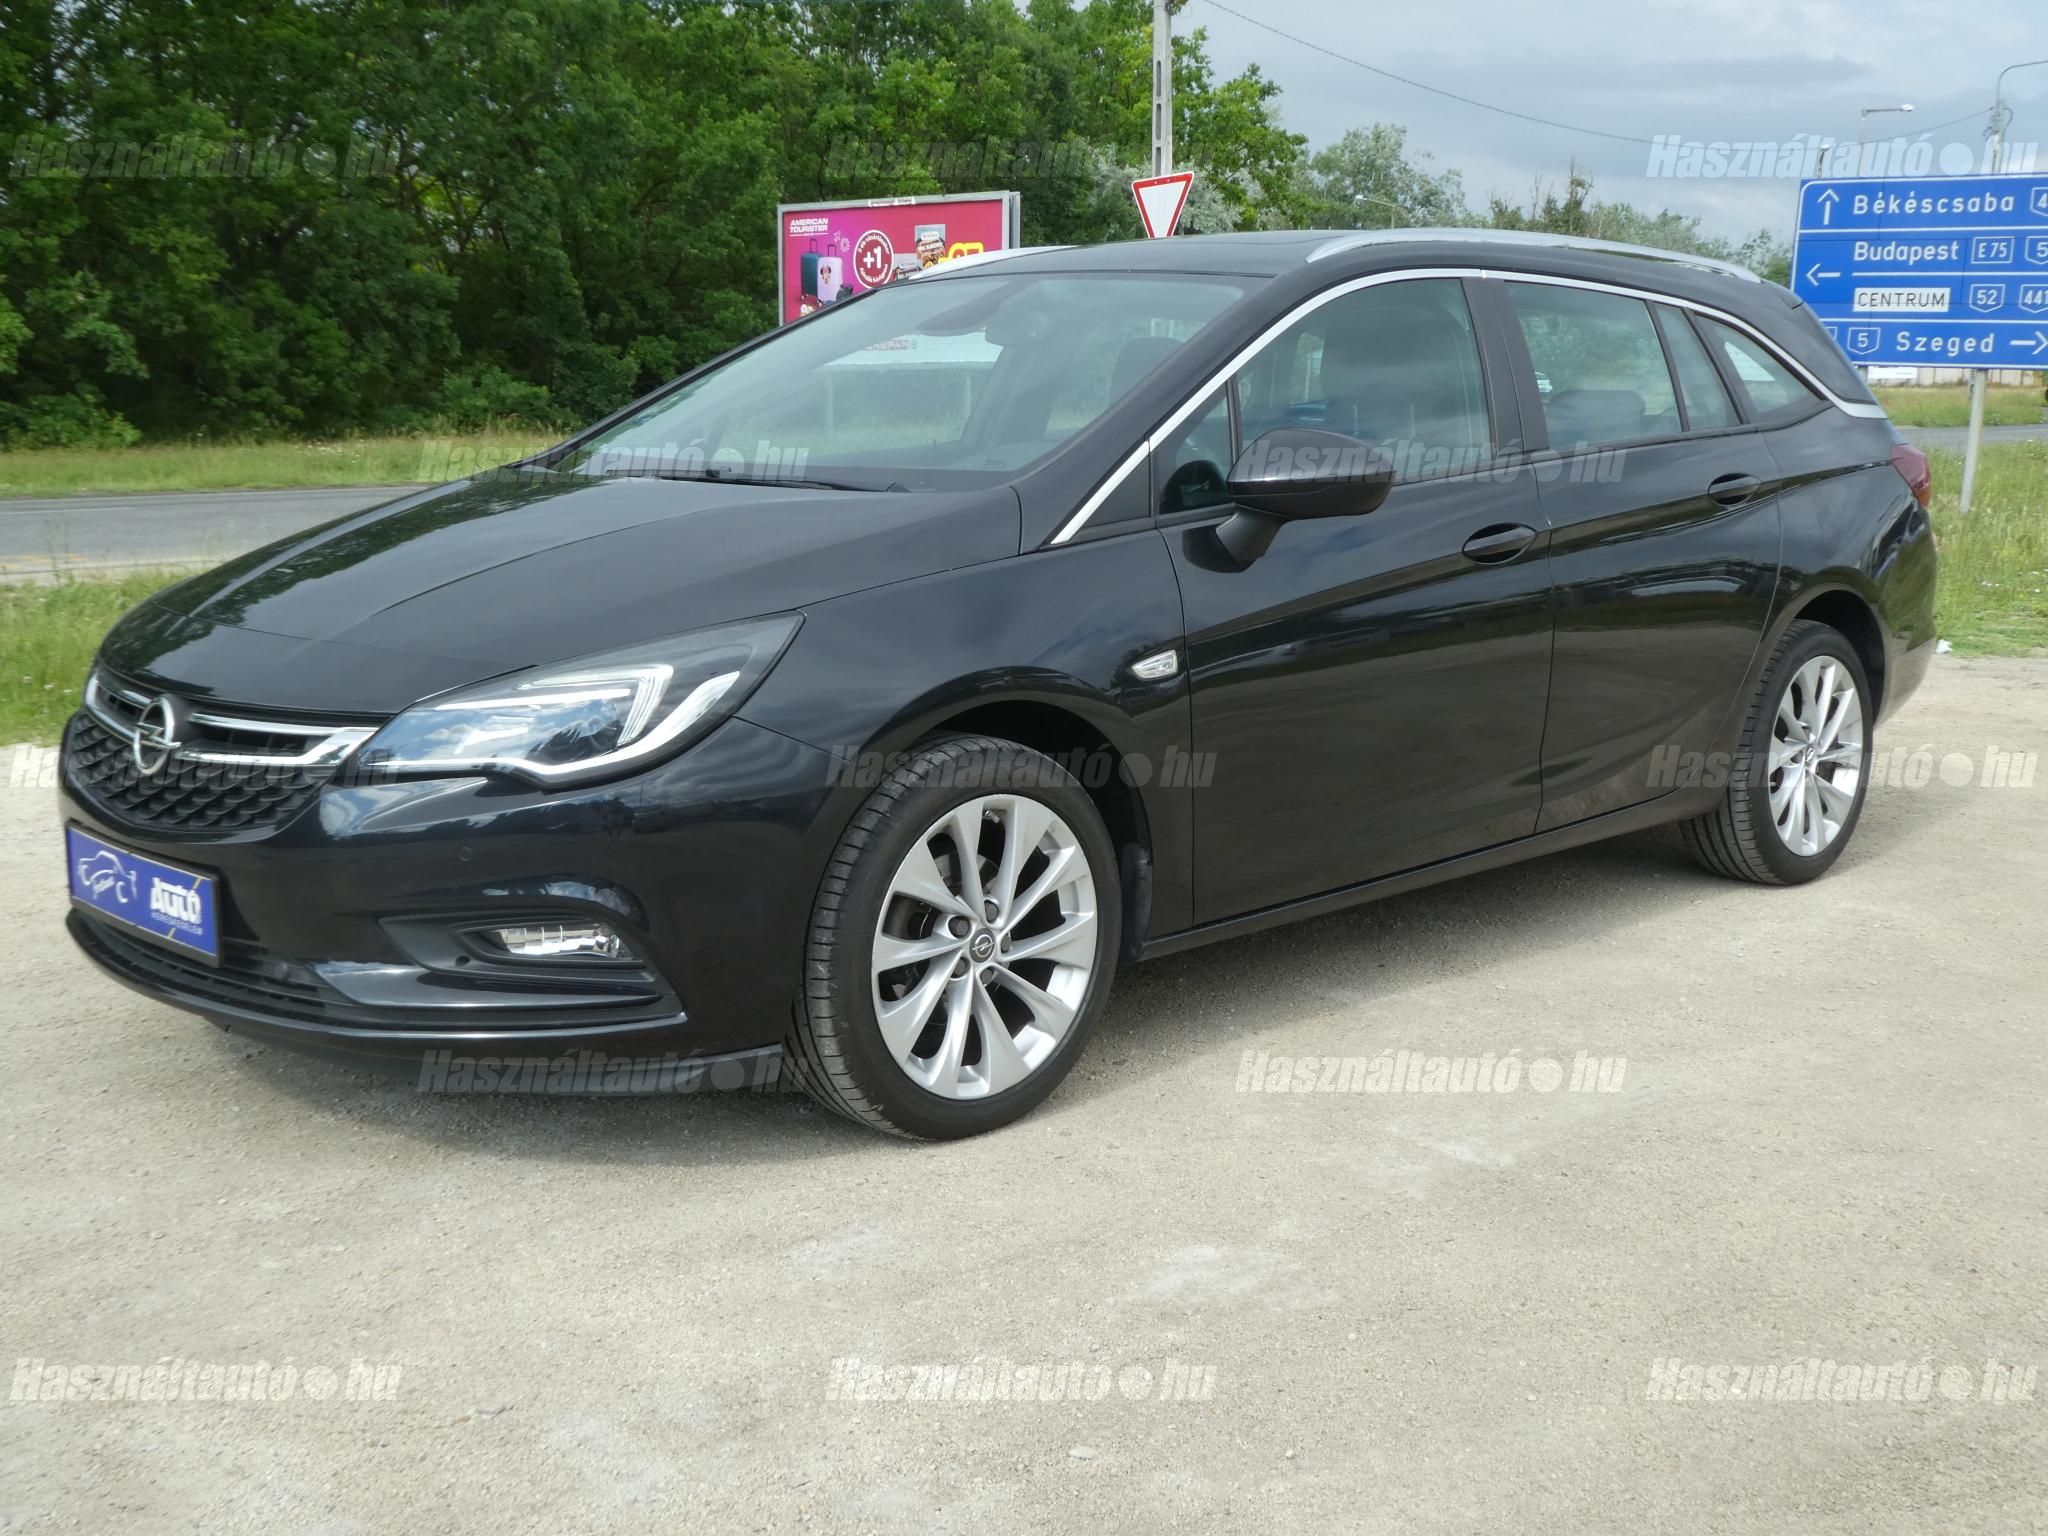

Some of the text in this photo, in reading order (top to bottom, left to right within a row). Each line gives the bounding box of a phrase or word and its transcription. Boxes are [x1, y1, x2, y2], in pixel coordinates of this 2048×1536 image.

[1853, 190, 2015, 215] Békéscsaba
[790, 217, 829, 226] AMERICAN
[790, 224, 828, 233] TOURISTER
[863, 245, 882, 269] +1
[1853, 241, 1960, 265] Budapest
[1857, 292, 1946, 307] CENTRUM
[1976, 289, 1998, 305] 52
[1857, 331, 1995, 356] 5 Szeged
